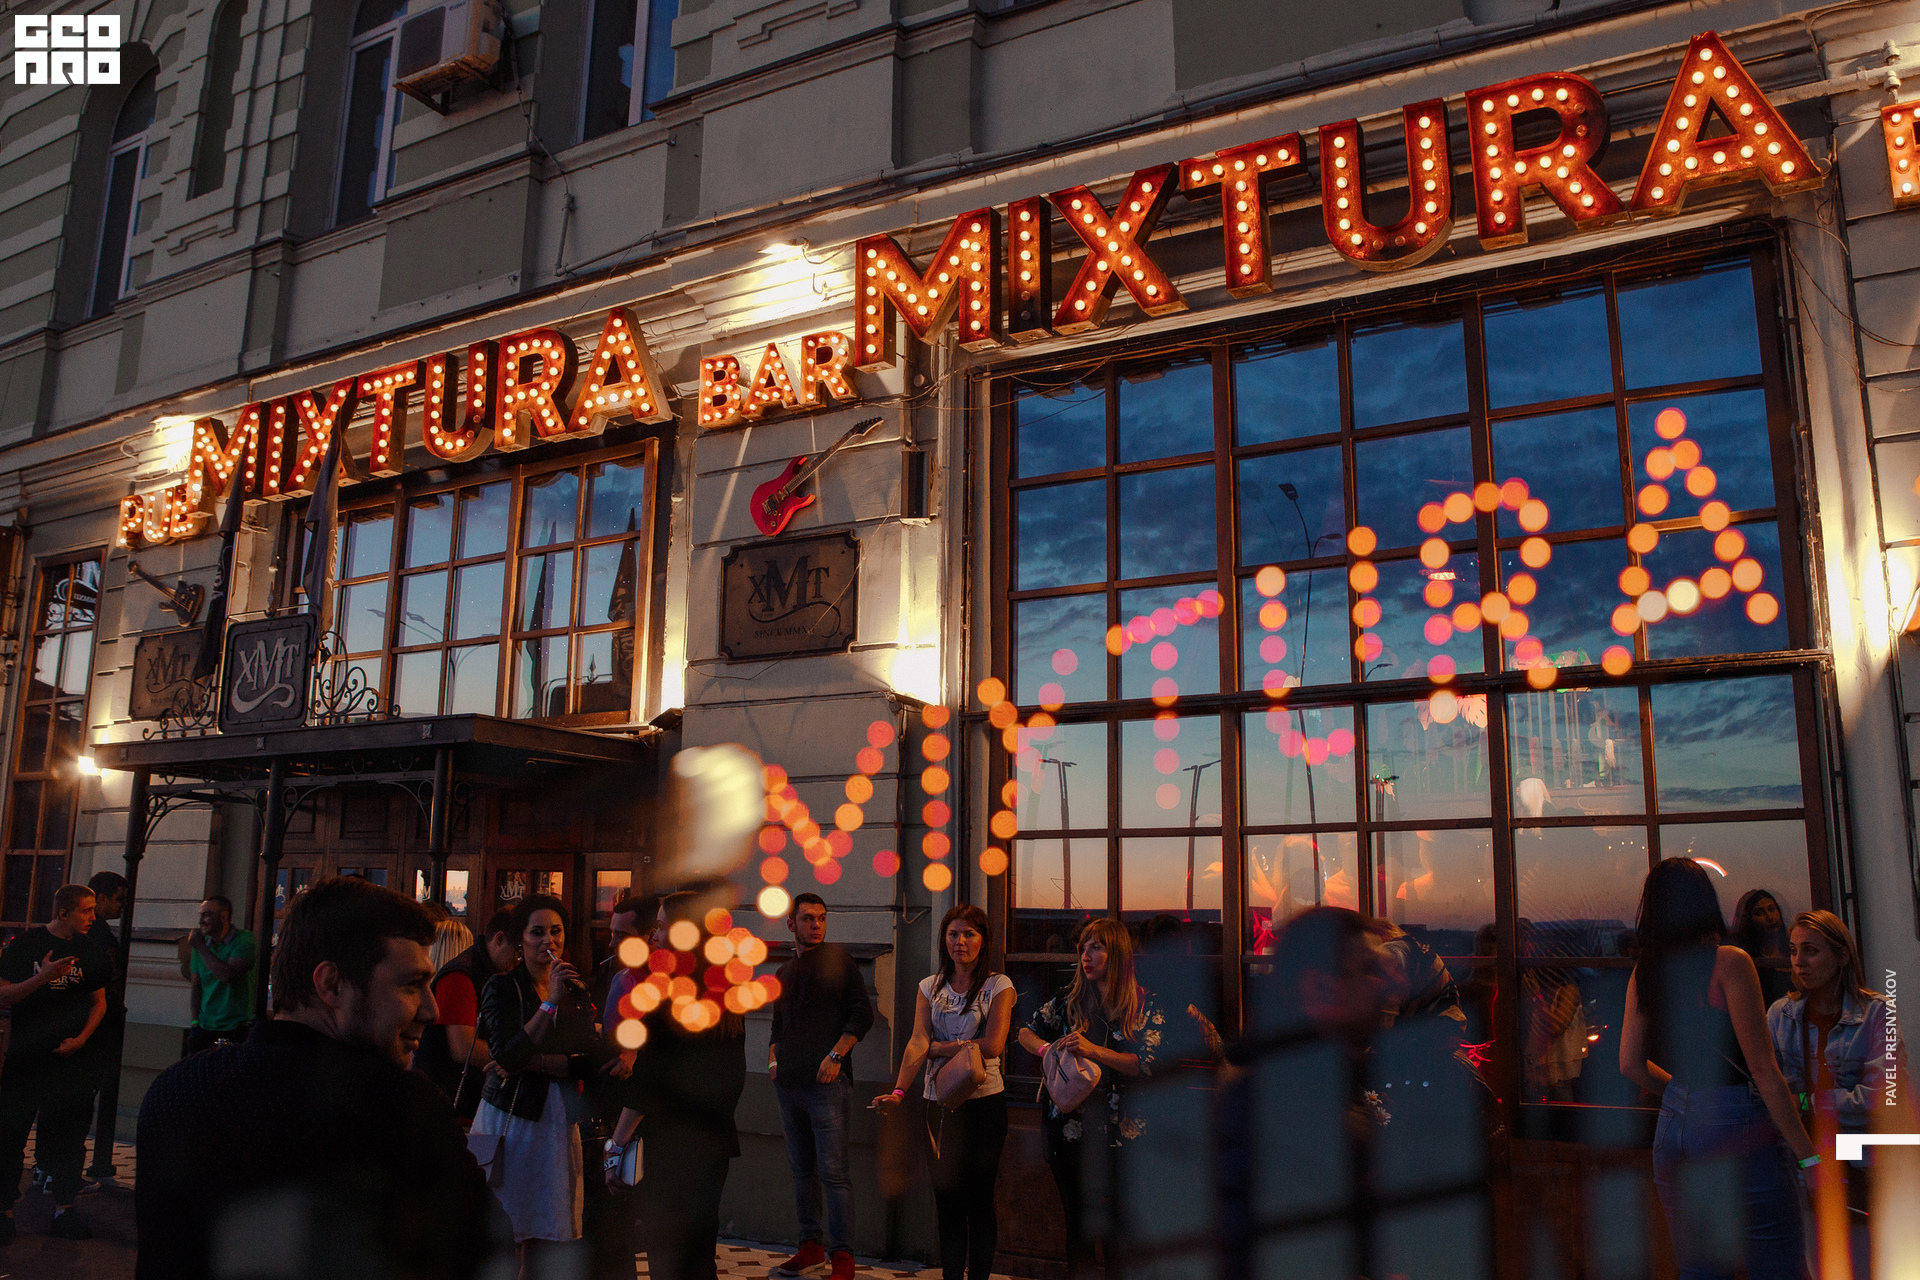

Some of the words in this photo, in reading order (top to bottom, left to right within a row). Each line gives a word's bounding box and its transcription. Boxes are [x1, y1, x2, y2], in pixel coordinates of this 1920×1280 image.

[855, 31, 1825, 372] MIXTURA
[186, 306, 673, 520] MIXTURA
[698, 330, 862, 429] BAR
[116, 482, 208, 550] PUB
[747, 554, 830, 613] XMT
[233, 637, 300, 691] XMT
